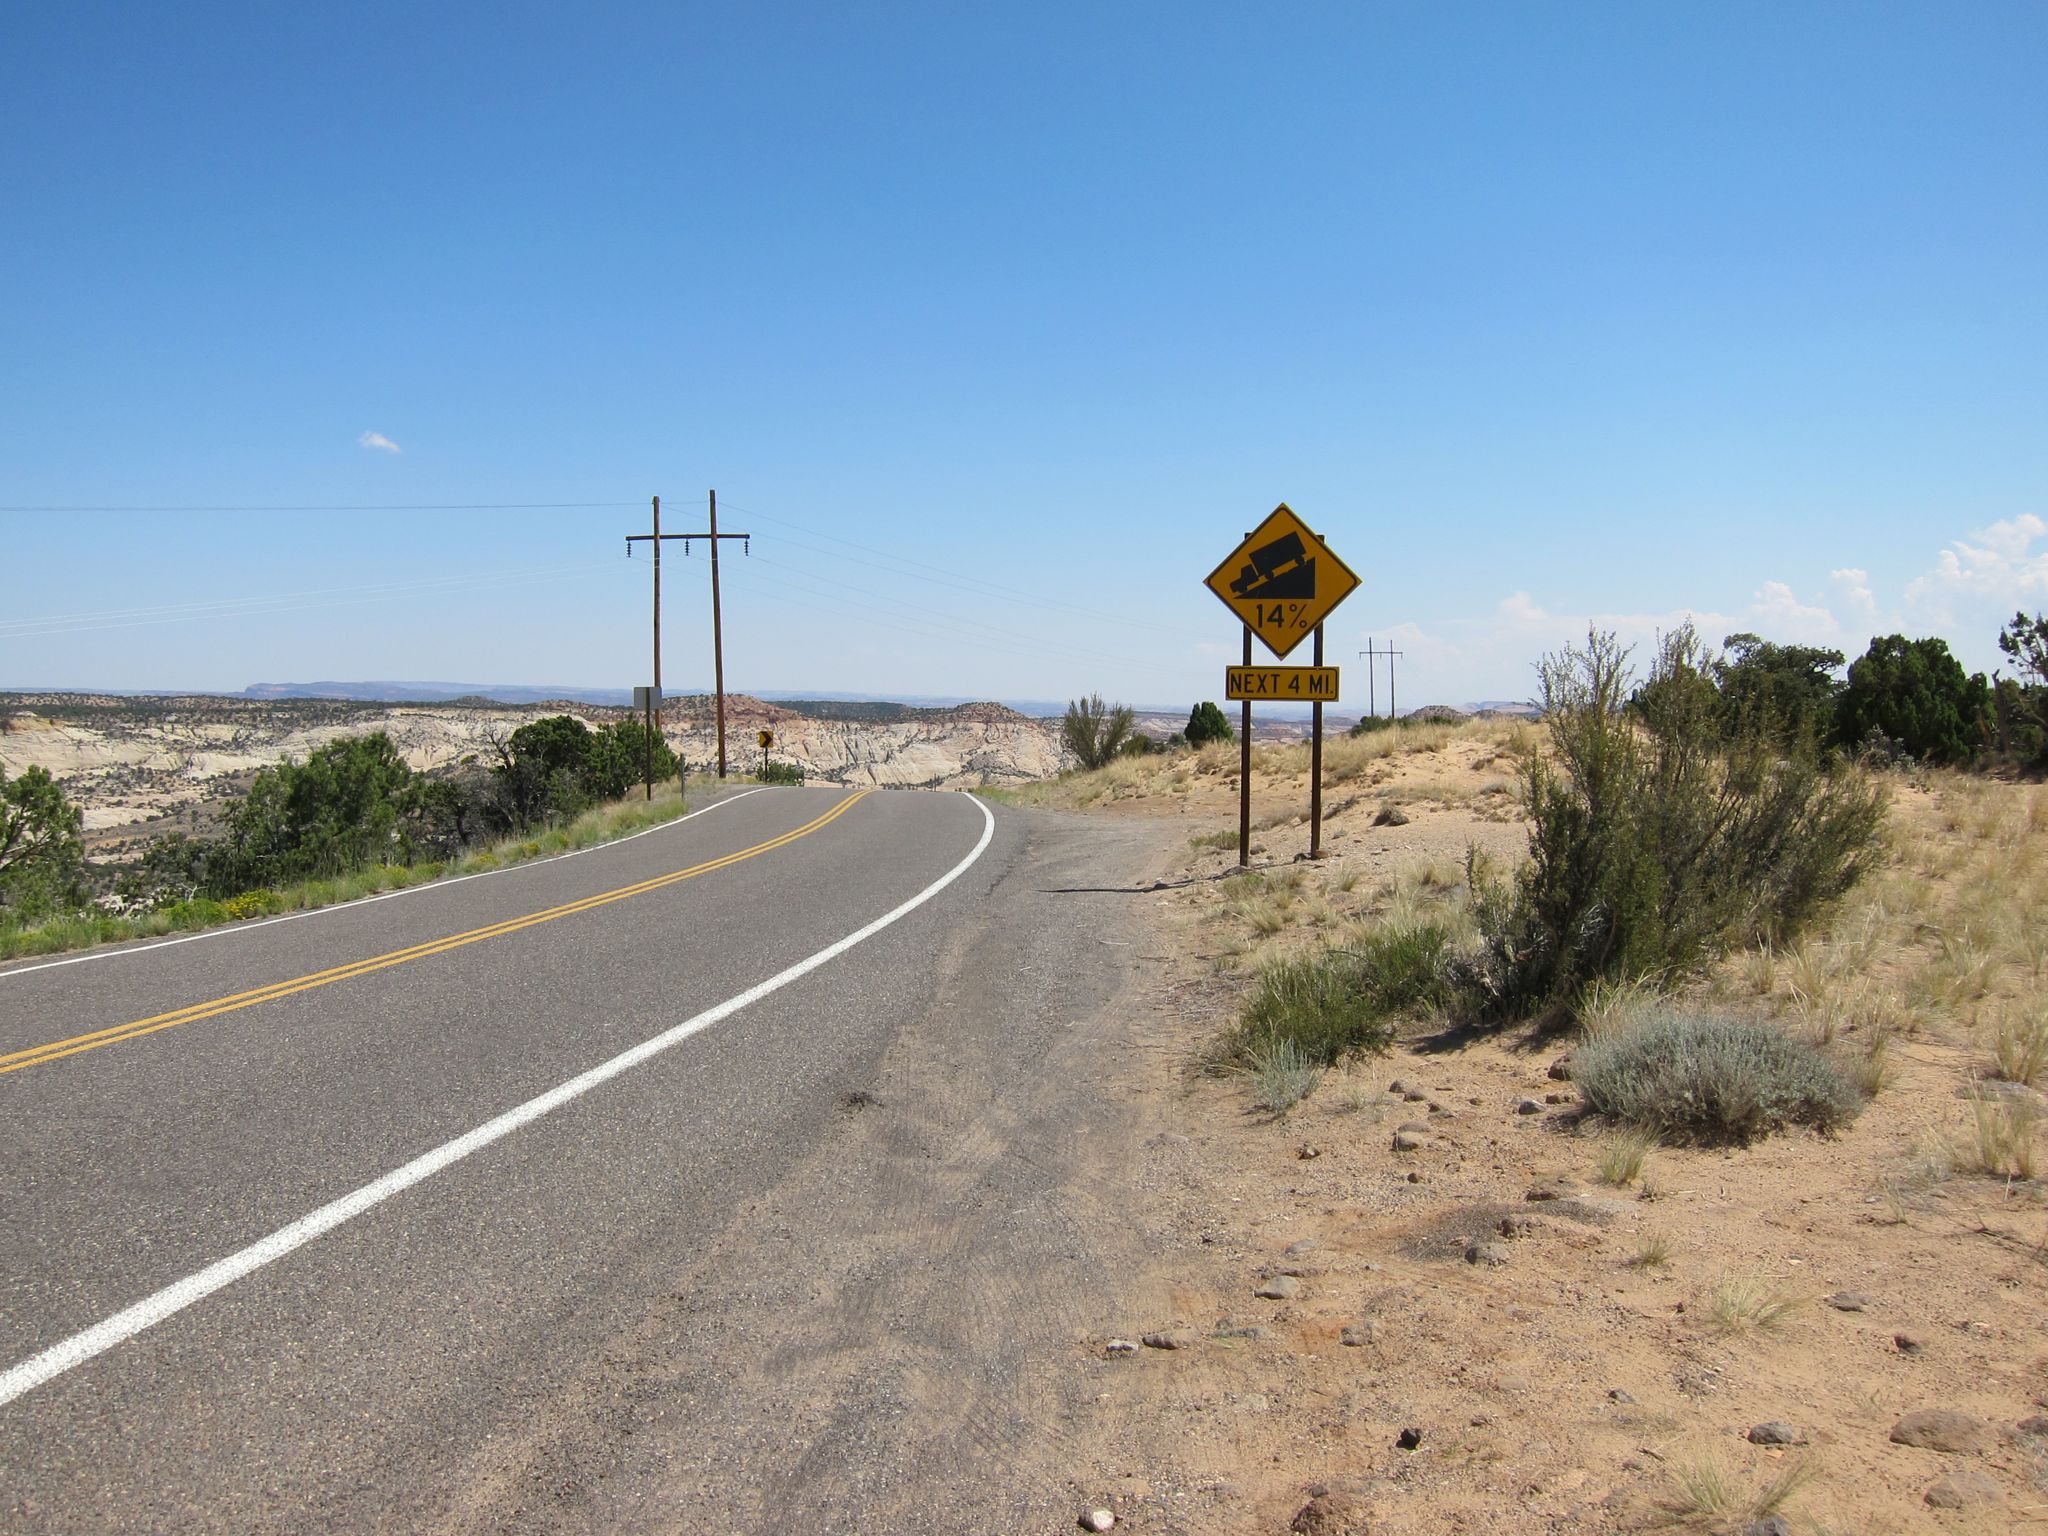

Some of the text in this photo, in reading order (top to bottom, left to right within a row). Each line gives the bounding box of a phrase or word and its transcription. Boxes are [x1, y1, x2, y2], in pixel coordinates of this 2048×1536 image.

[1256, 603, 1307, 629] 14%
[1230, 673, 1334, 694] NEXT 4 MI.
